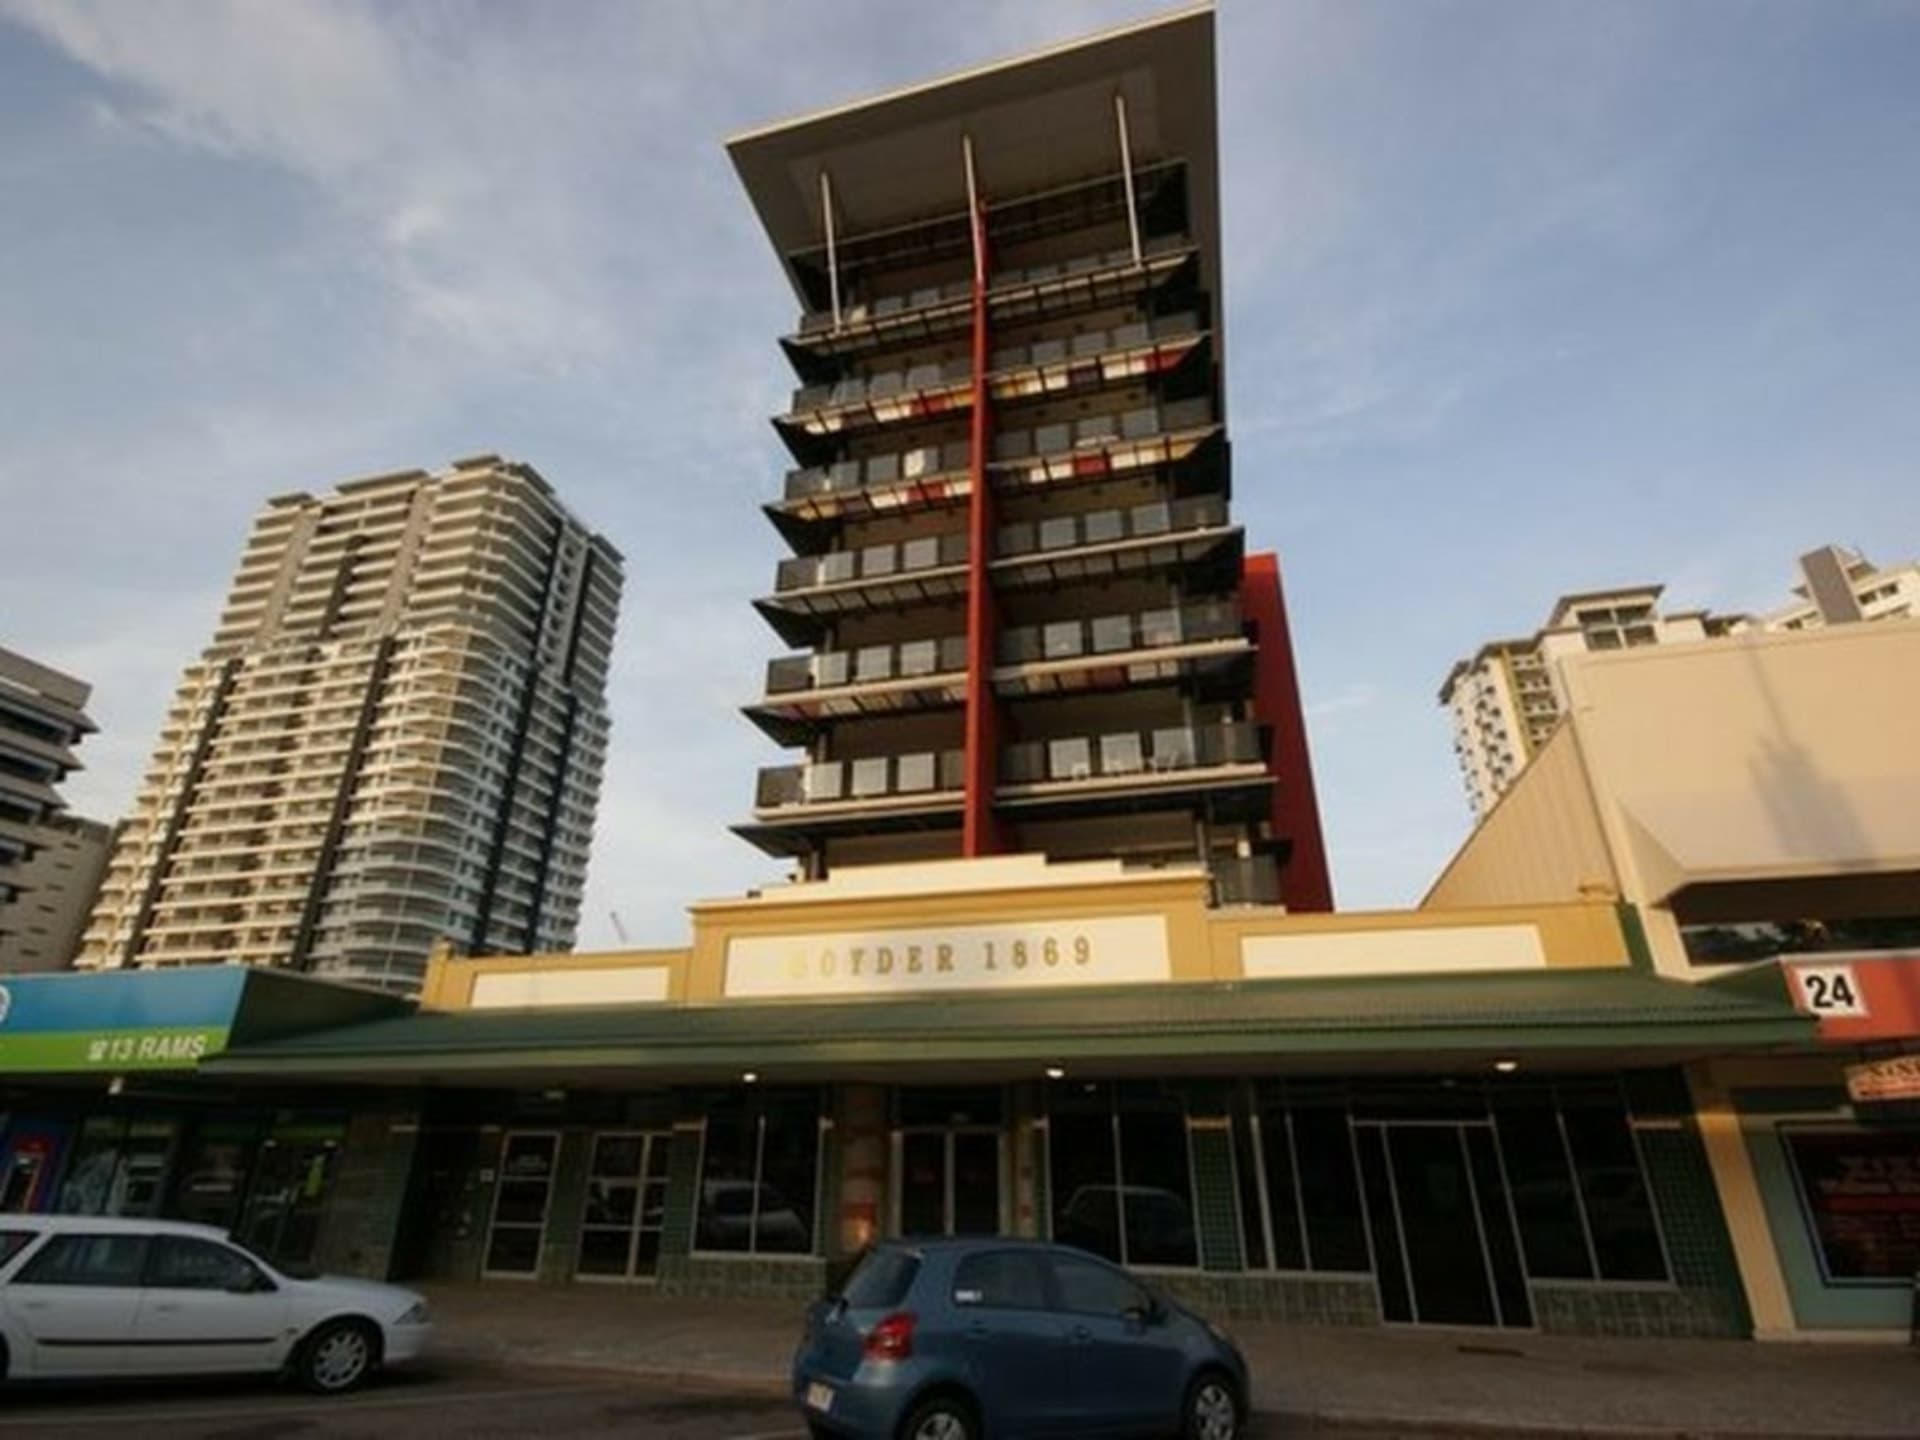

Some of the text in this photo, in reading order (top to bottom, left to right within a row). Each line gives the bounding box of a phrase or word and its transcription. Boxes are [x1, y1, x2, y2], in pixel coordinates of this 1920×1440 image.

[983, 936, 1091, 971] 1869
[1806, 974, 1854, 1008] 24
[138, 1034, 207, 1059] RAMS
